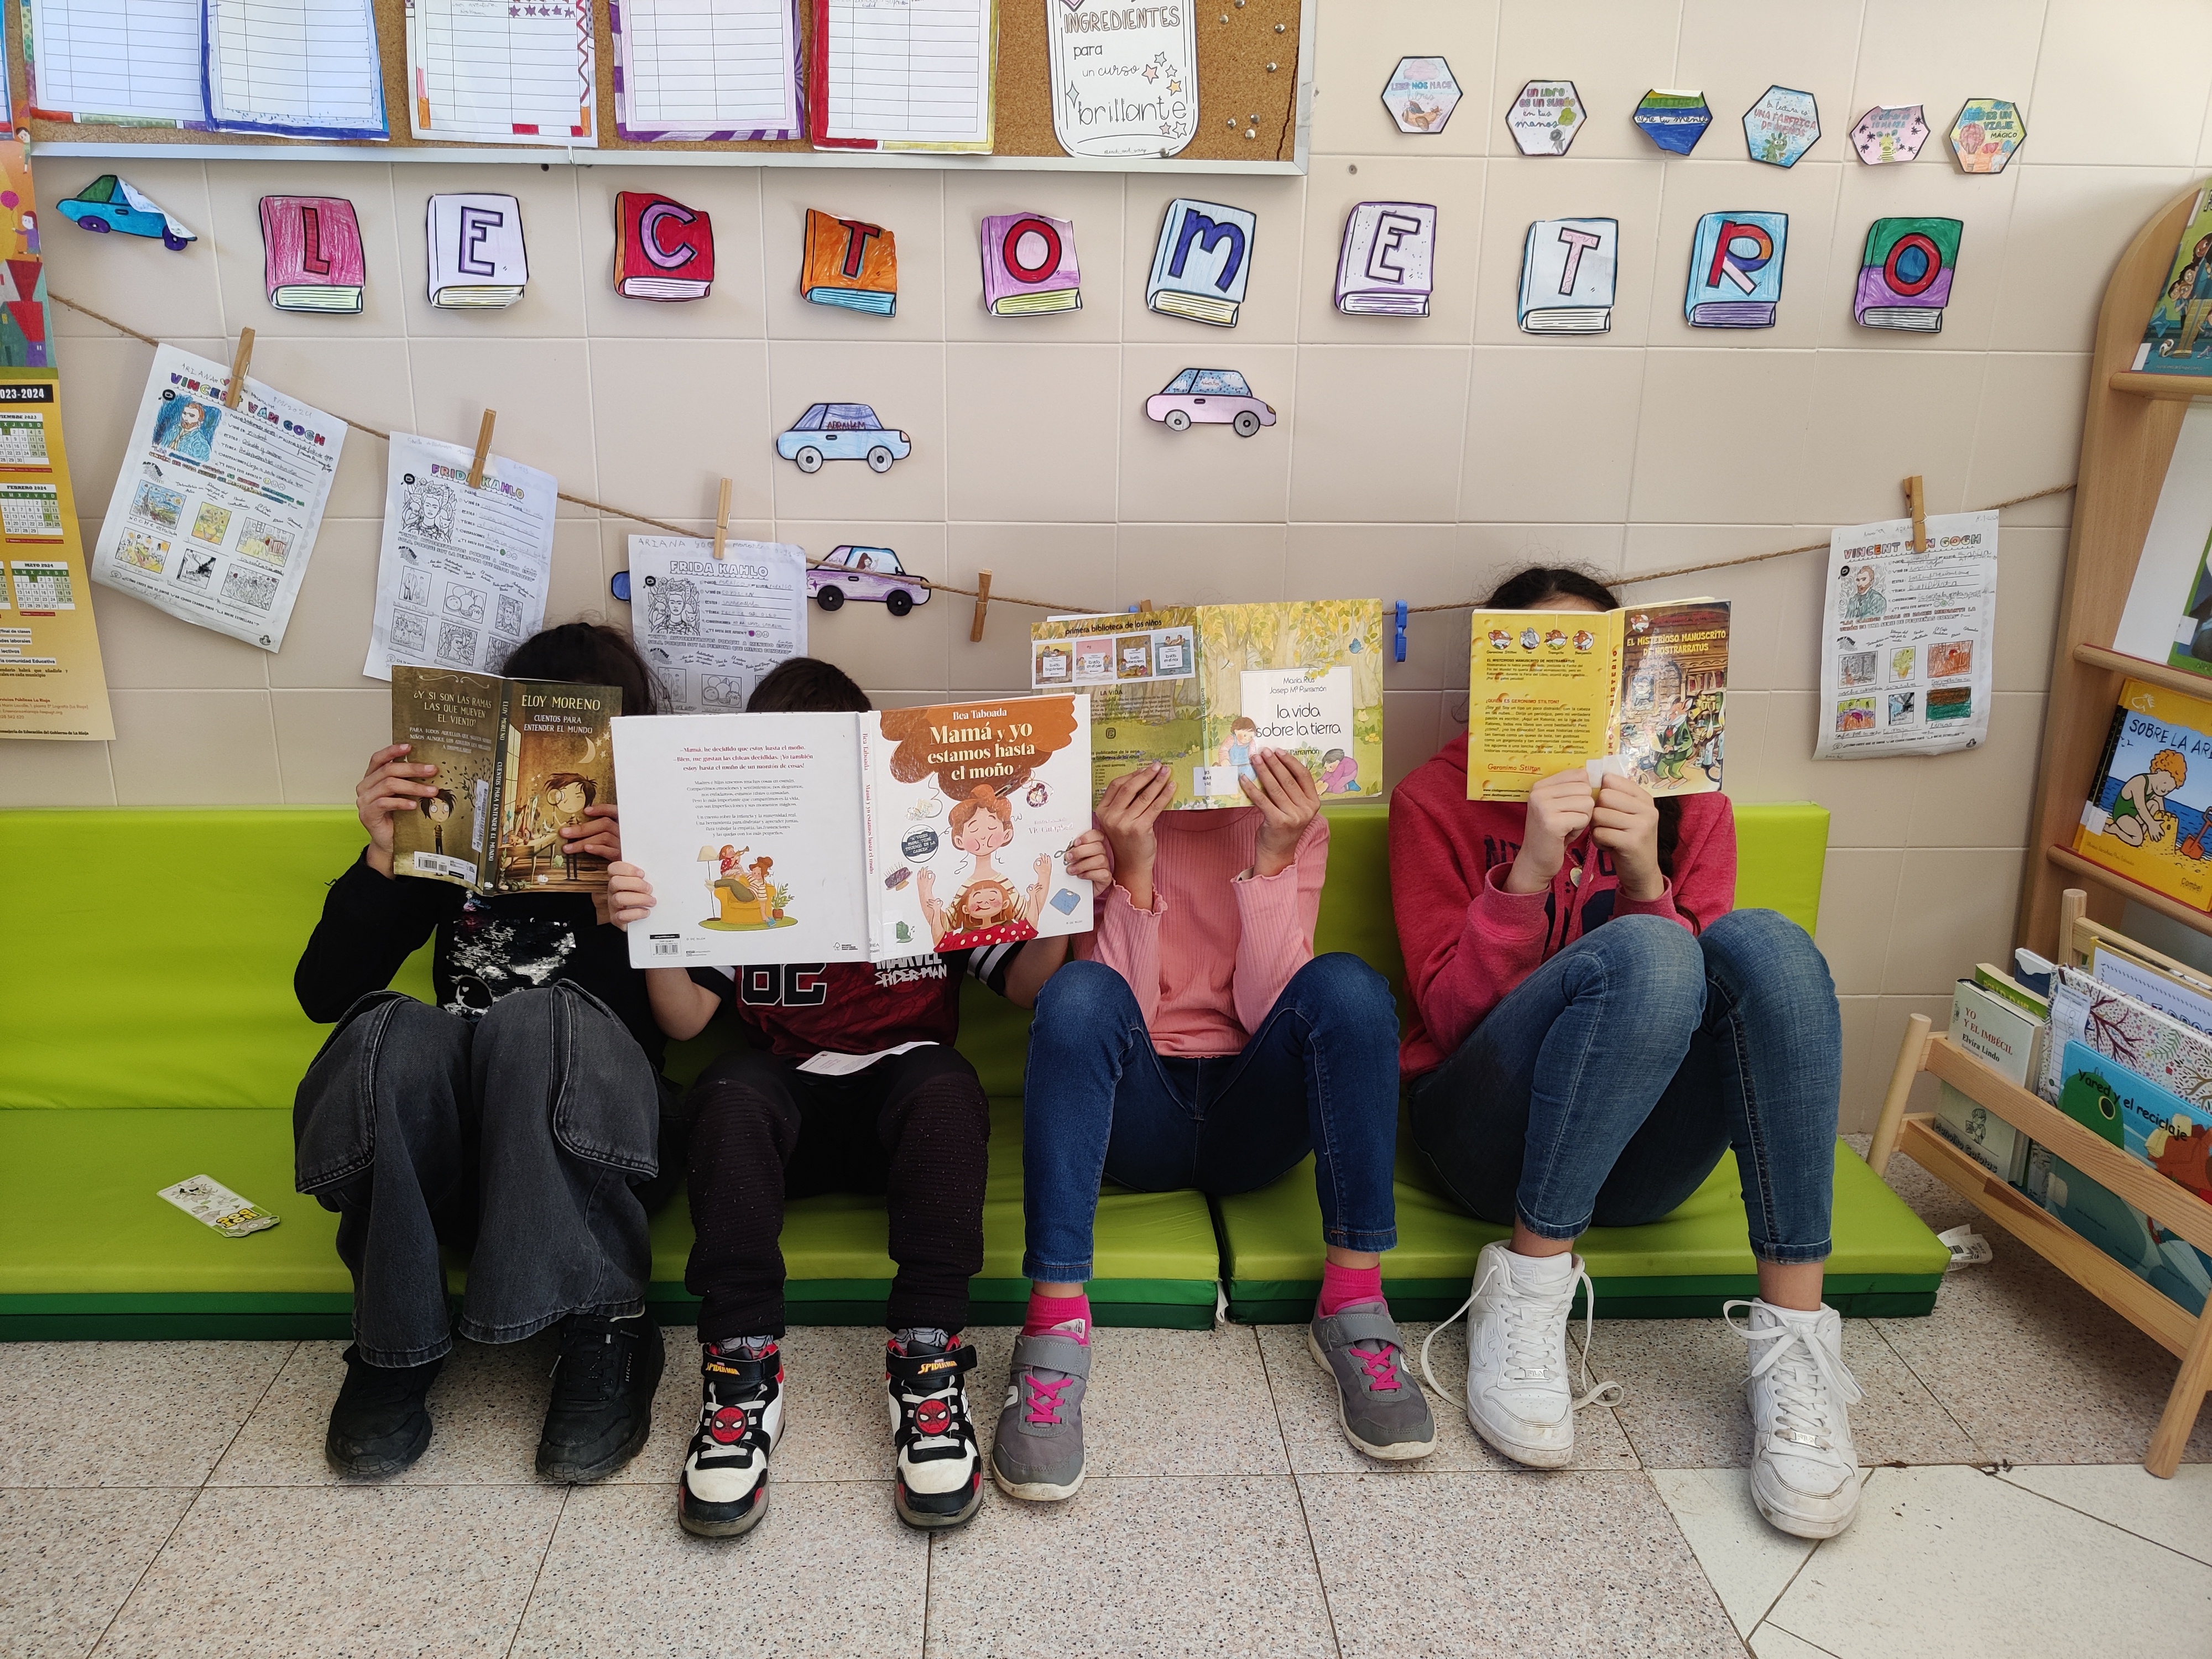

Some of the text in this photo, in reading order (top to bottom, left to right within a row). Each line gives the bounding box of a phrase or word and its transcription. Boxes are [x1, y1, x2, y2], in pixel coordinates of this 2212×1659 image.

[1064, 6, 1180, 33] INGREDIENTES
[1073, 45, 1102, 59] para
[1098, 65, 1140, 76] curso
[1078, 96, 1187, 125] brillante
[303, 206, 331, 276] L
[458, 205, 504, 277] E
[639, 201, 699, 272] C
[837, 218, 886, 280] T
[1001, 218, 1064, 283] O
[1365, 210, 1427, 285] E
[1556, 226, 1601, 298] T
[1706, 220, 1771, 298] R
[1884, 230, 1944, 299] O
[0, 388, 44, 398] 023-2024
[283, 420, 326, 446] GOGH
[481, 476, 524, 500] KAHLO
[1844, 534, 1982, 560] VINCENT GOGH
[670, 561, 768, 577] FRIDA KAHLO
[1065, 627, 1089, 636] primera
[1091, 624, 1123, 633] biblioteca
[1627, 630, 1726, 646] EL MISTERIOSO MANUSCRITO
[440, 693, 455, 702] SON
[457, 696, 469, 705] LAS
[472, 698, 492, 708] RAMAS
[522, 695, 601, 711] ELOY MORENO
[424, 702, 485, 718] LAS QUE MUEVEN
[953, 708, 1007, 721] Bea Taboada
[1277, 703, 1321, 719] la vida
[437, 714, 476, 727] EL VIENTO?
[534, 714, 582, 724] CUENTOS PARA
[524, 724, 554, 733] ENTENDER
[568, 725, 593, 734] MUNDO
[930, 721, 1032, 745] Mamá y yo
[1256, 721, 1341, 738] sobre la tierra
[2129, 719, 2187, 750] SOBRE LA
[927, 742, 1035, 764] estamos hasta
[951, 764, 1013, 781] el moño
[488, 841, 497, 861] MUNDO
[1965, 1007, 1976, 1020] YO
[1964, 1019, 2013, 1055] Y EL IMBÉCIL
[1963, 1034, 2000, 1062] Elvira Lindo
[2078, 1068, 2111, 1097] Yared
[2124, 1098, 2133, 1110] el
[2136, 1106, 2188, 1142] reciclaje
